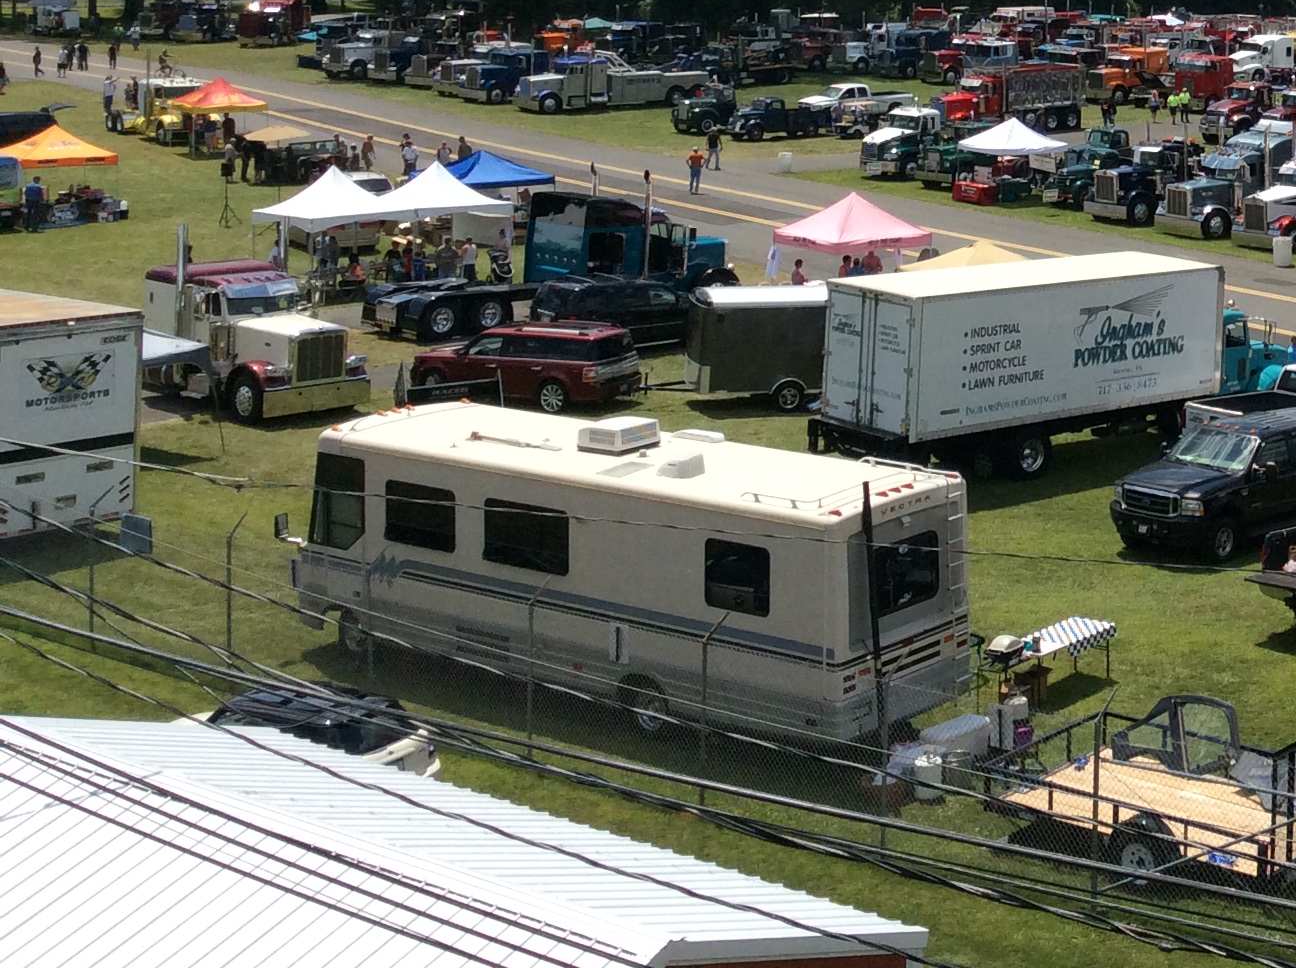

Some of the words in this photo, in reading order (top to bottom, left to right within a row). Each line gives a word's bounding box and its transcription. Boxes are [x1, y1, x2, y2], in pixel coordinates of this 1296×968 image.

[970, 322, 1022, 340] INDUSTRIAL
[1094, 310, 1166, 346] Ingham's
[969, 341, 1001, 357] SPRINT
[1003, 339, 1022, 352] CAR
[1073, 343, 1129, 369] POWDER
[1131, 335, 1185, 361] COATING
[968, 355, 1027, 374] MOTORCYCLE
[968, 376, 995, 391] LAWN
[998, 369, 1045, 387] FURNITURE
[25, 388, 110, 408] MOTORSPORTS
[880, 495, 932, 516] VECTRA
